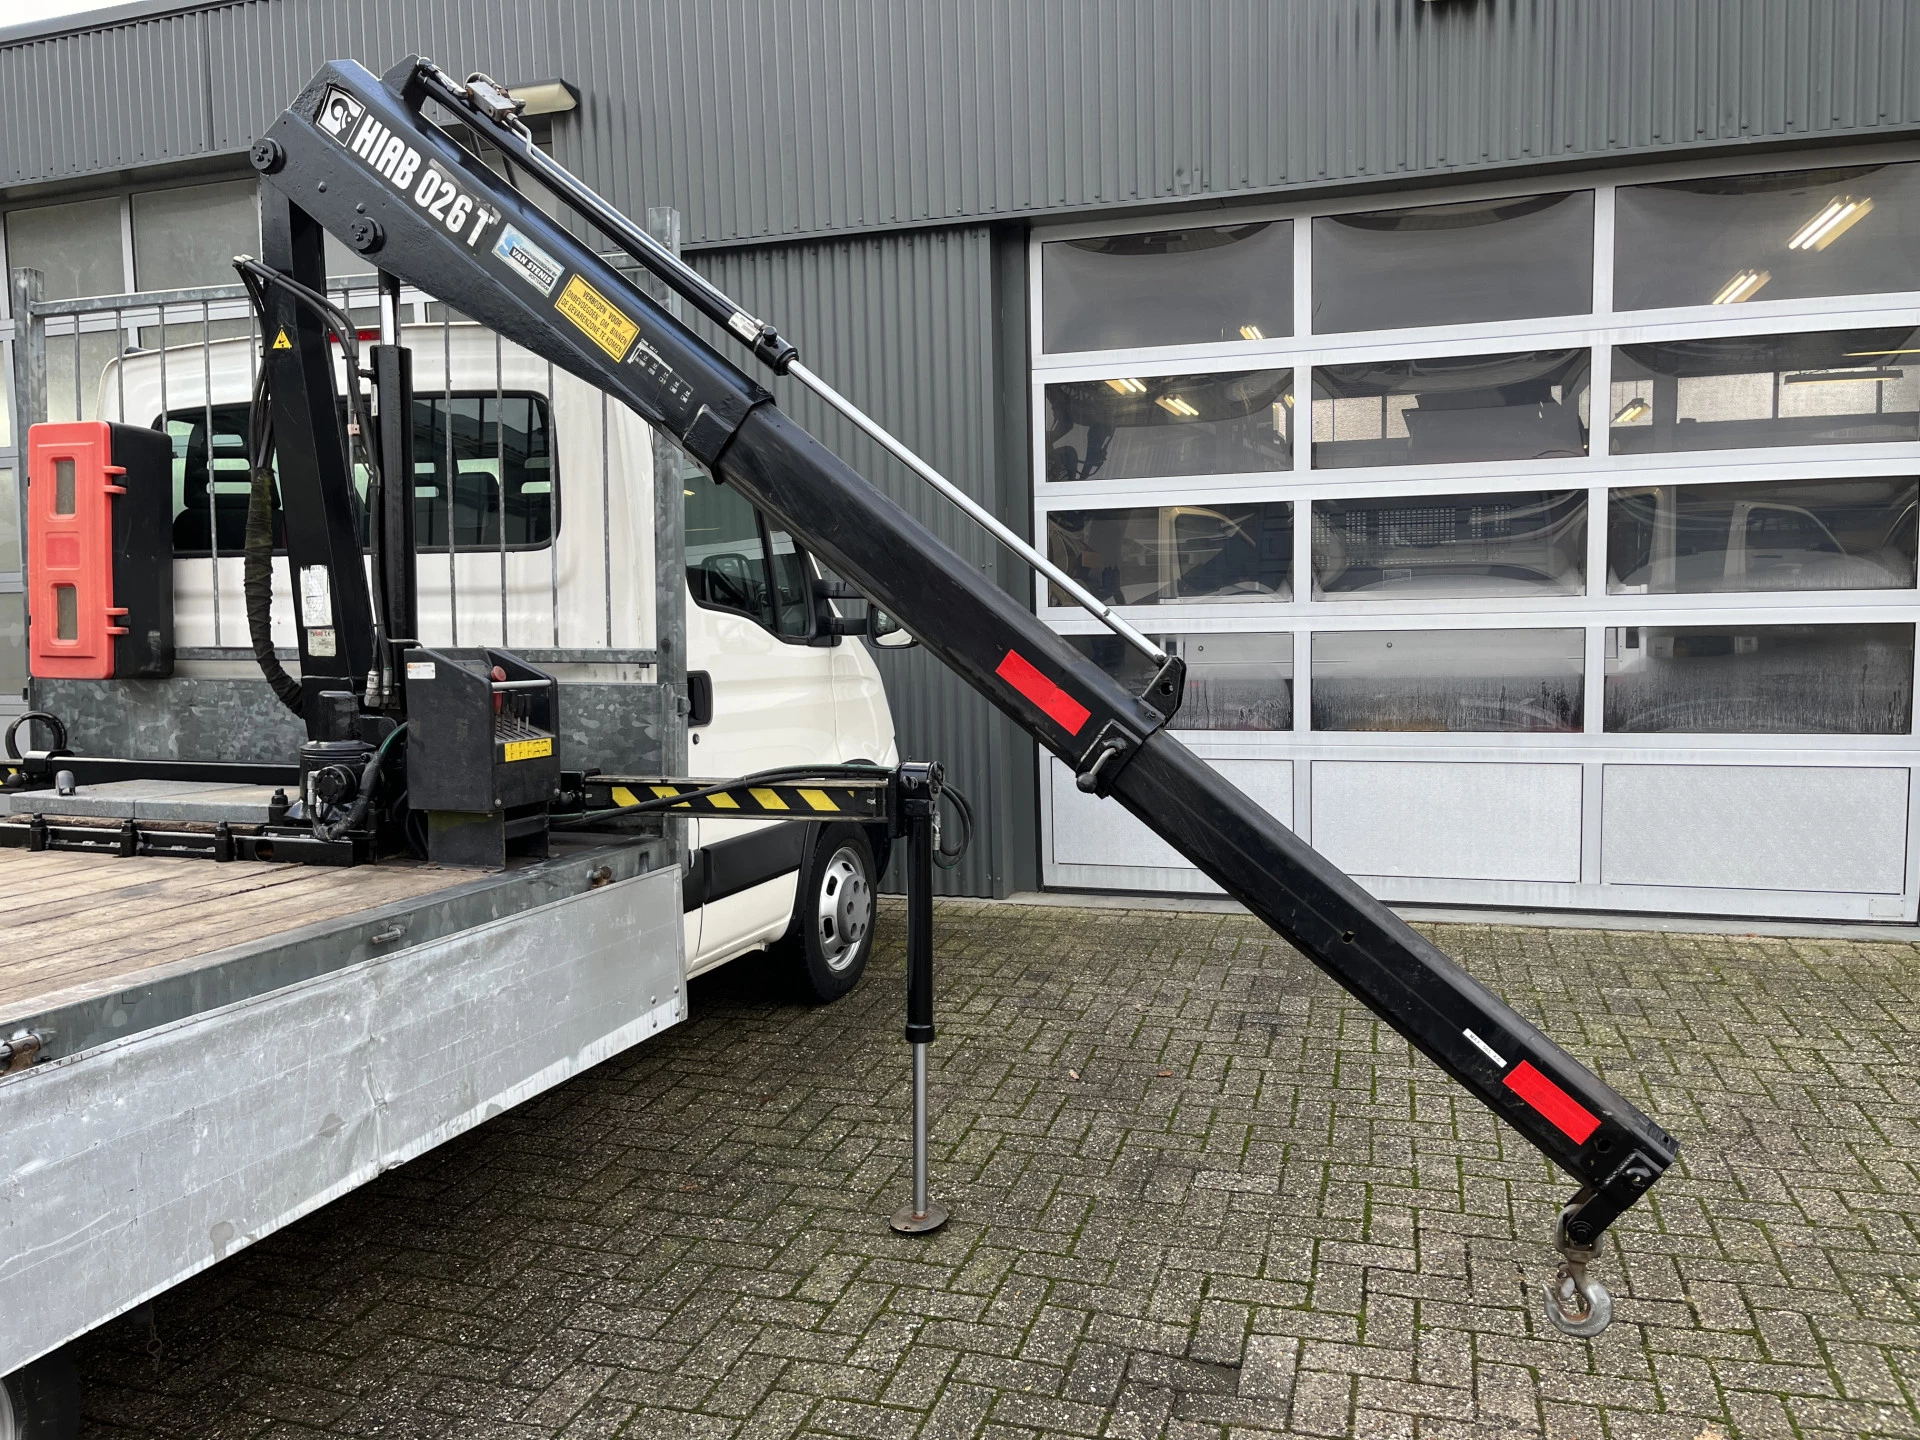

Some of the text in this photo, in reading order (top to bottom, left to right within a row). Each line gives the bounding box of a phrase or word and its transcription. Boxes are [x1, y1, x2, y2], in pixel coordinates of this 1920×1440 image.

[351, 114, 422, 190] HIAB
[414, 168, 473, 233] 026
[511, 248, 528, 265] VAN
[526, 261, 553, 284] STENIS
[528, 273, 550, 291] ROTTERDAM
[560, 297, 623, 354] DE GEVARENZONE TE KOMEN
[566, 289, 600, 321] ONBEVOEGDEN
[599, 318, 610, 330] OM
[609, 326, 628, 346] BINNEN
[582, 290, 623, 328] VERBODEN VOOR
[1470, 1034, 1480, 1044] MAX
